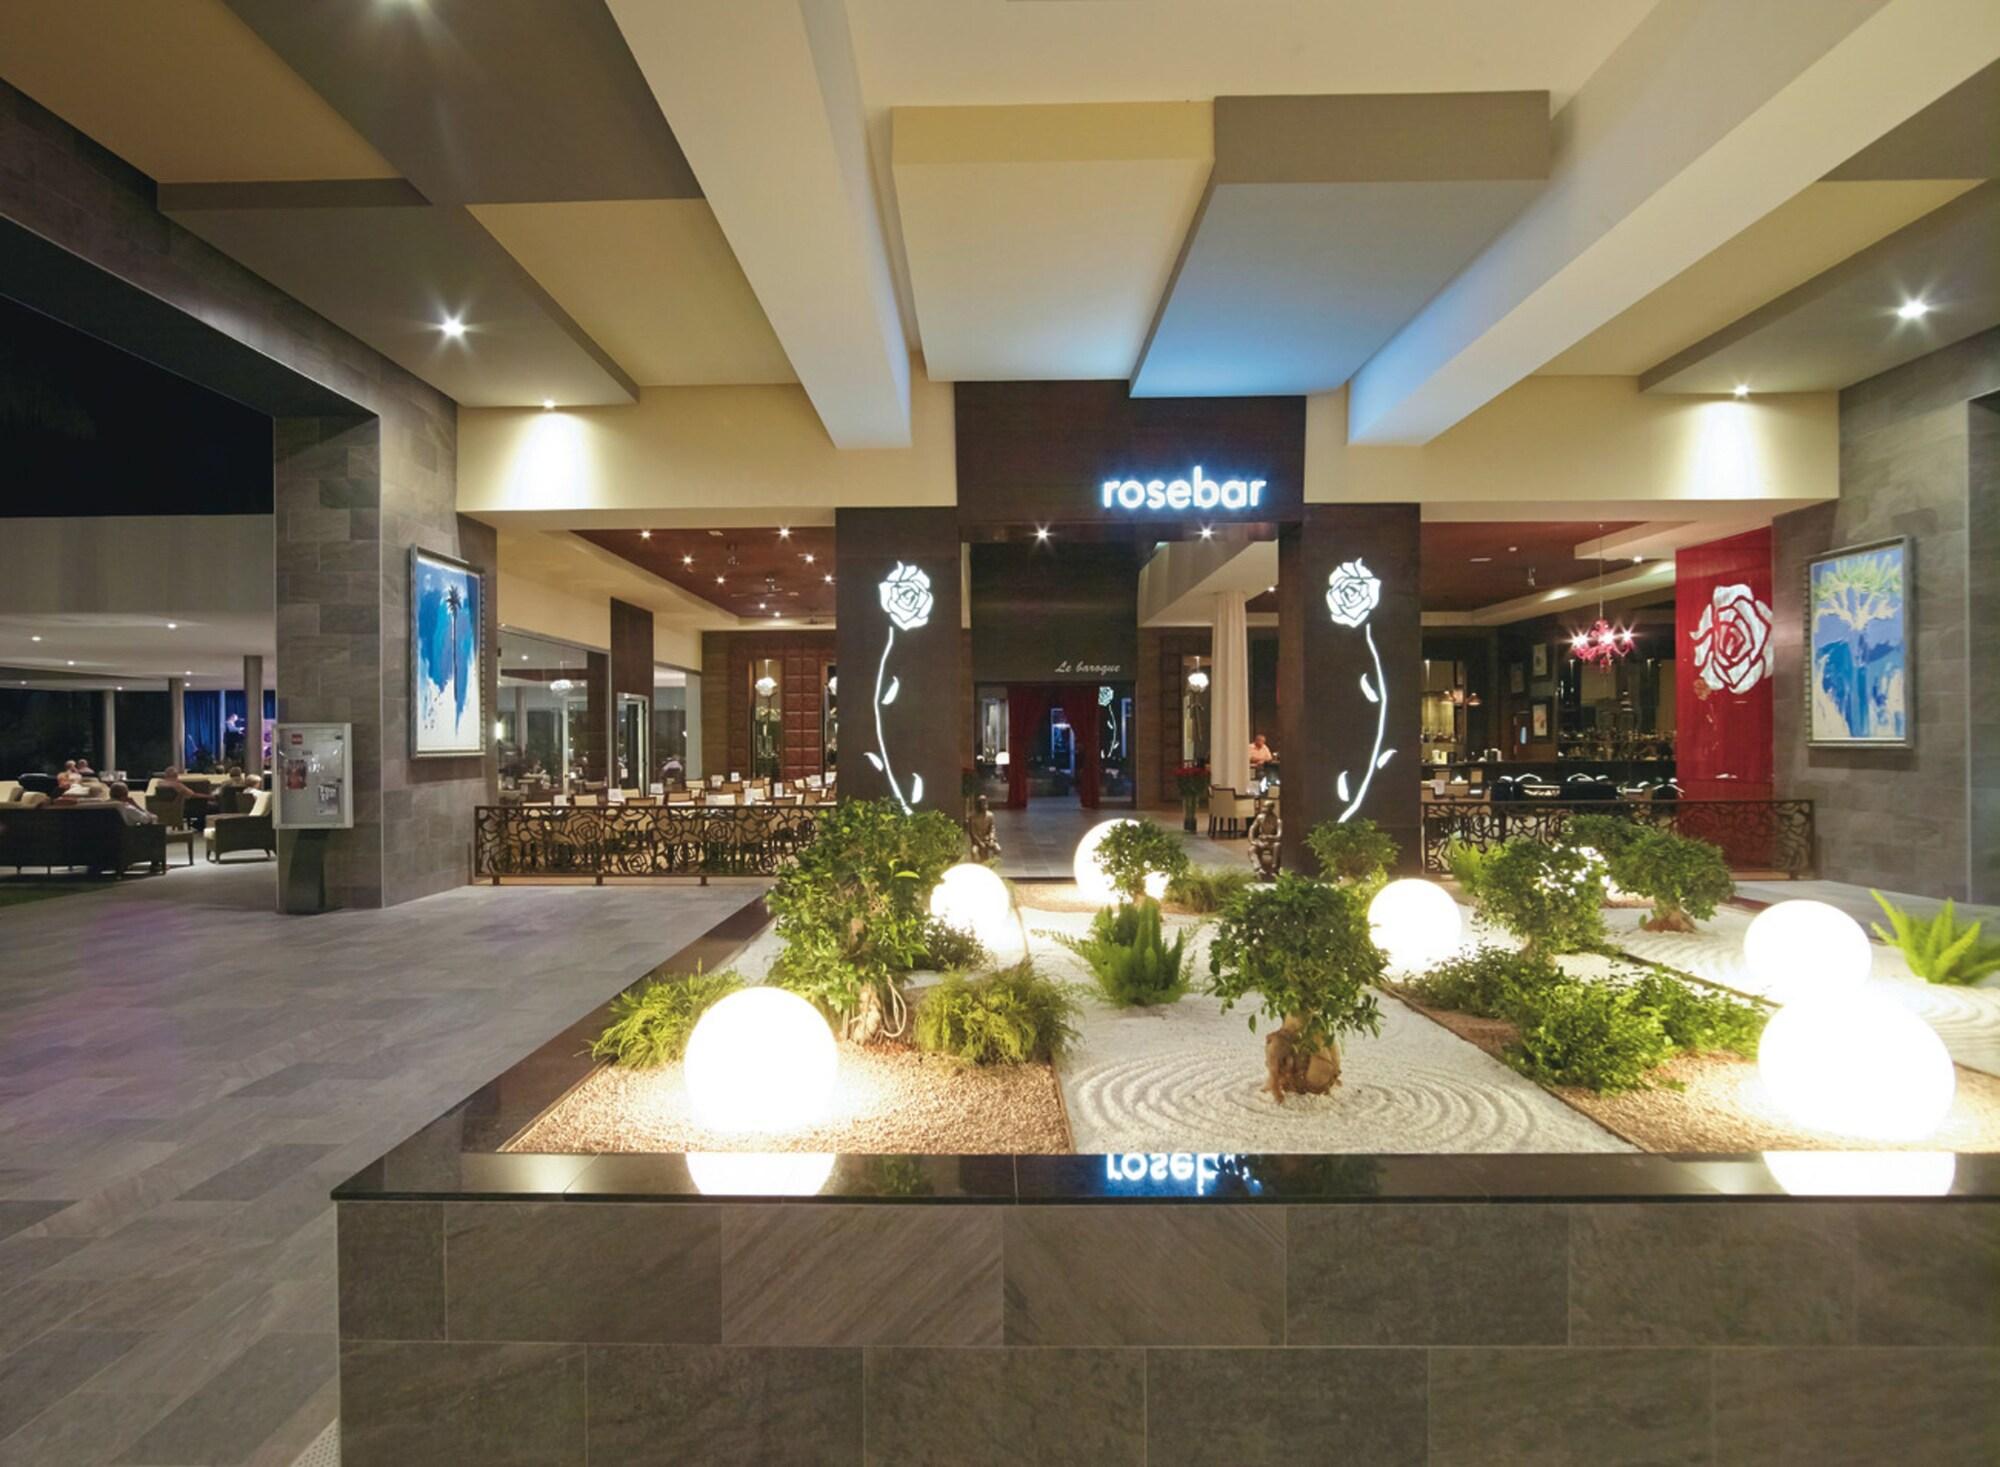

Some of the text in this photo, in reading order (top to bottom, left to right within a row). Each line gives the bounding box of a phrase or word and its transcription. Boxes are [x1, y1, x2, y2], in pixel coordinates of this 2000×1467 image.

[1103, 465, 1266, 509] rosebar
[1054, 660, 1121, 676] Le baroque
